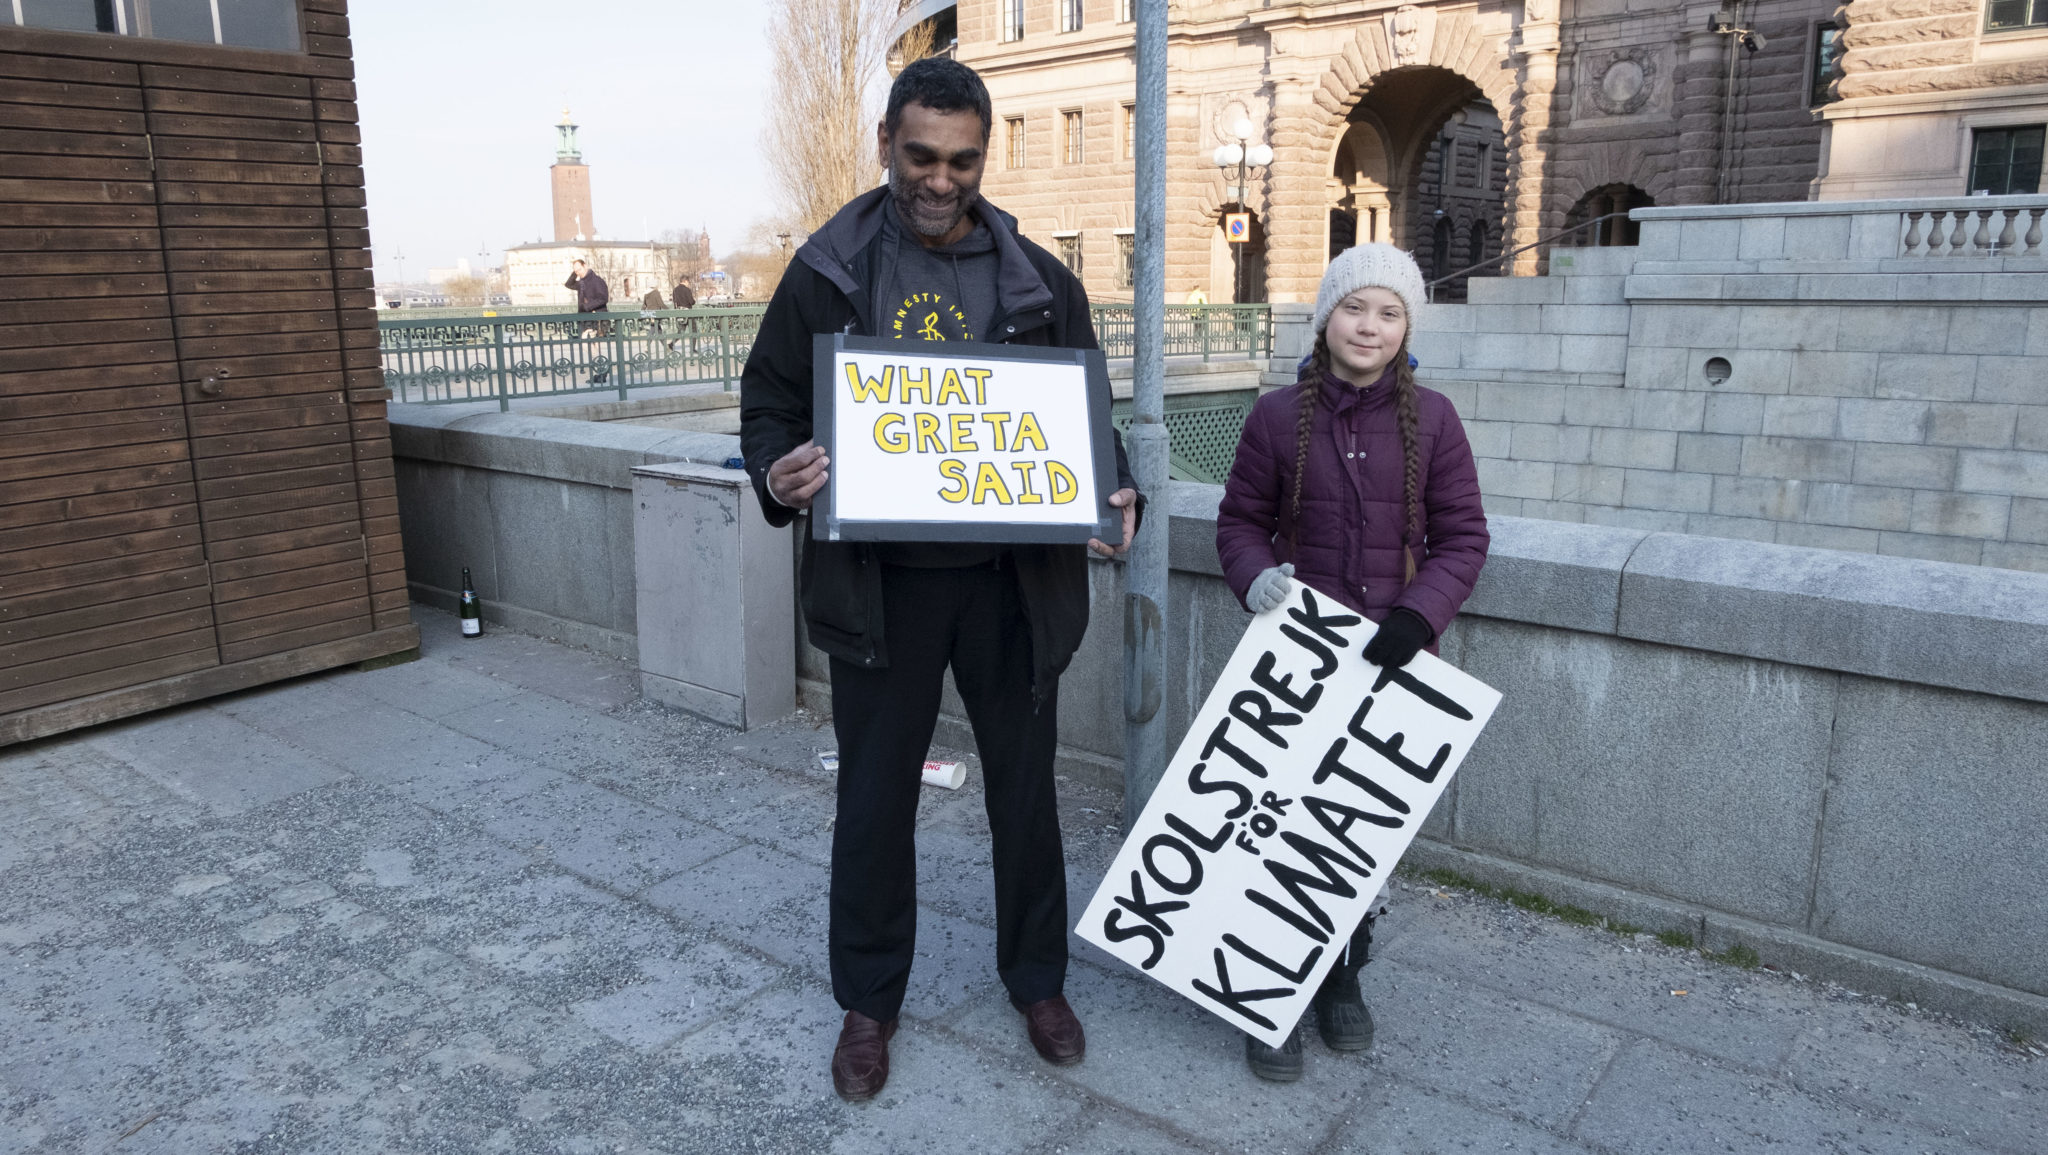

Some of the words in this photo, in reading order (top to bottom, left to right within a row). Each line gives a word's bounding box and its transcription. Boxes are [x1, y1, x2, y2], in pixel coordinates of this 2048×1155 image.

[844, 362, 993, 405] WHAT
[872, 411, 1049, 454] GRETA
[937, 458, 1079, 505] SAID
[1103, 587, 1362, 970] SKOLSTREJK
[1191, 666, 1474, 1031] KLIMATET
[1235, 790, 1293, 855] FÖR
